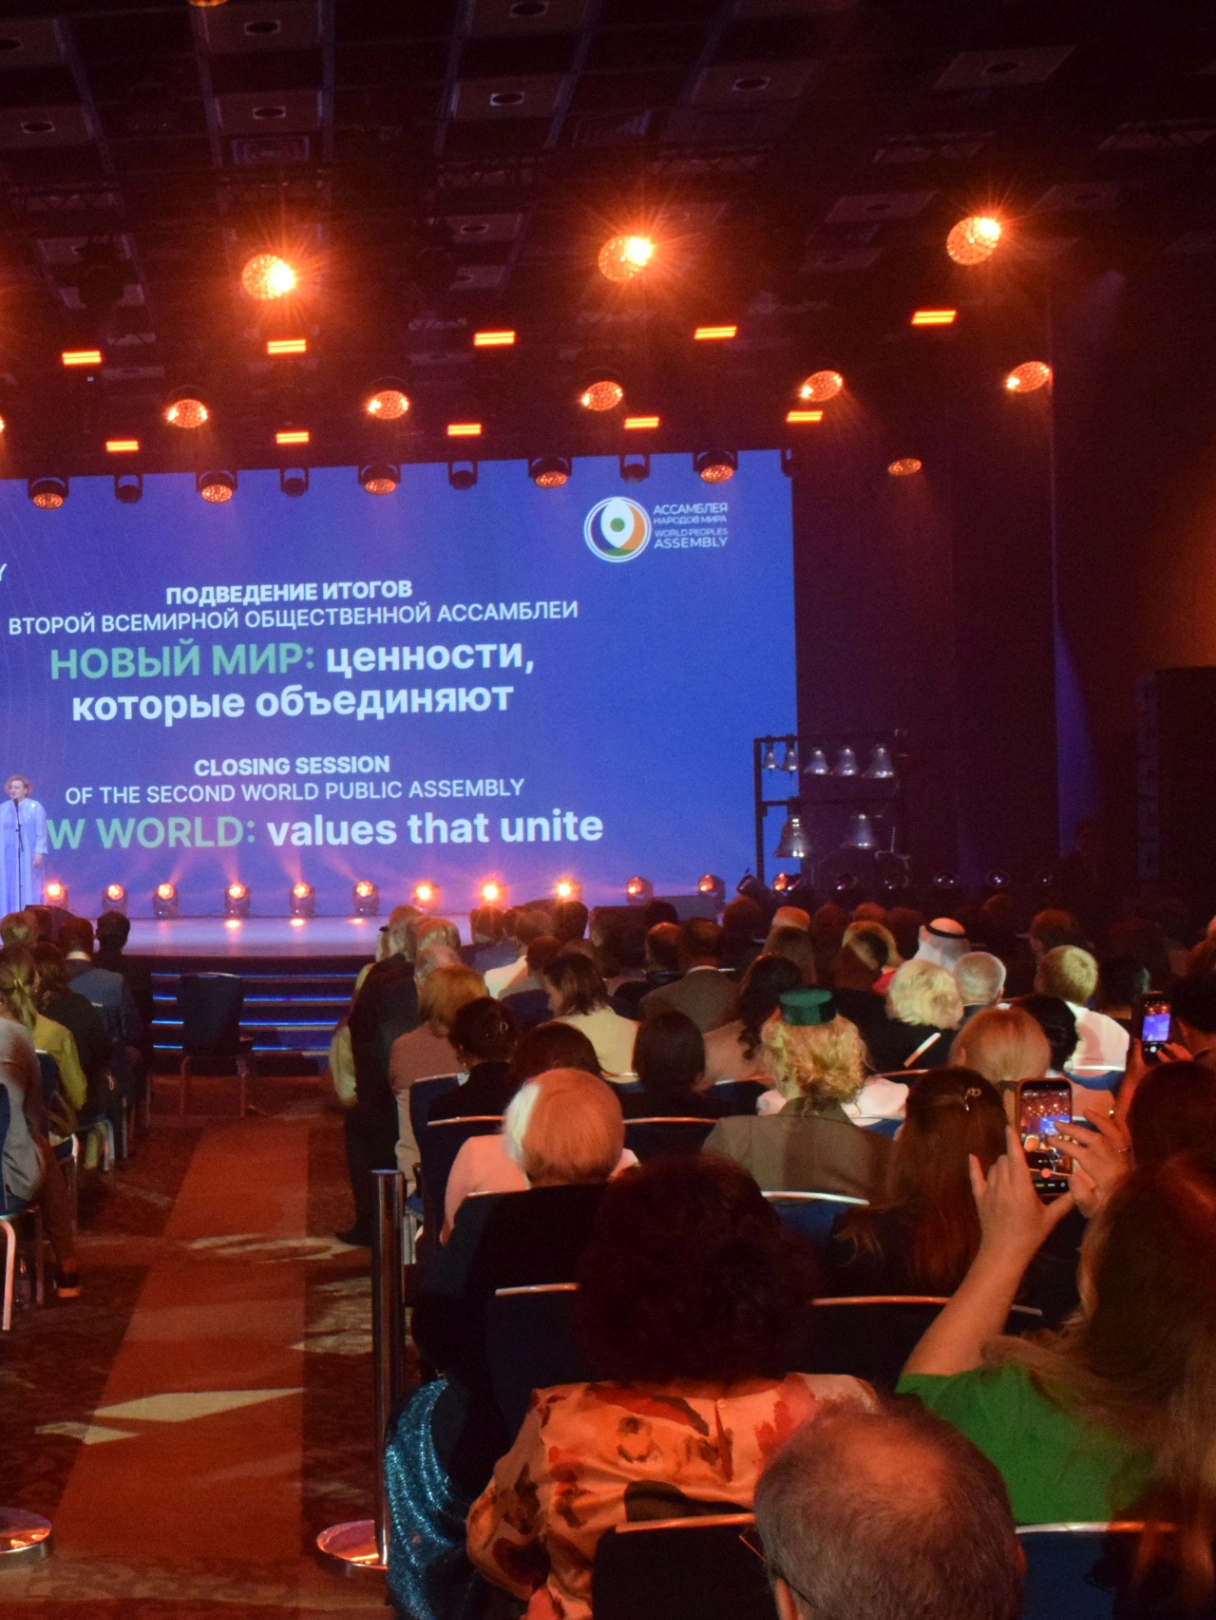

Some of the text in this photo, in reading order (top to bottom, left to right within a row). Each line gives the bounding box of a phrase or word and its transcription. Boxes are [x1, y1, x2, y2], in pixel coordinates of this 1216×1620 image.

[653, 502, 728, 515] АССАМБЛЕЯ
[653, 515, 728, 525] НАРОДОВ МИРА
[653, 536, 728, 549] ASSEMBLY
[654, 527, 728, 538] WORLD PEOPLES
[166, 580, 413, 607] ПОДВЕДЕНИЕ ИТОГОВ
[8, 600, 579, 635] ВТОРОЙ ВСЕМИРНОЙ ОБЩЕСТВЕННОЙ АССАМБЛЕИ
[51, 637, 534, 680] НОВЫЙ МИР: ценности,
[72, 685, 514, 728] которые объединяют
[194, 755, 391, 777] CLOSING SESSION
[65, 777, 525, 805] OF THE SECOND WORLD PUBLIC ASSEMBLY
[96, 815, 256, 849] WORLD:
[266, 813, 398, 847] values
[407, 811, 490, 844] that
[500, 807, 604, 842] unite
